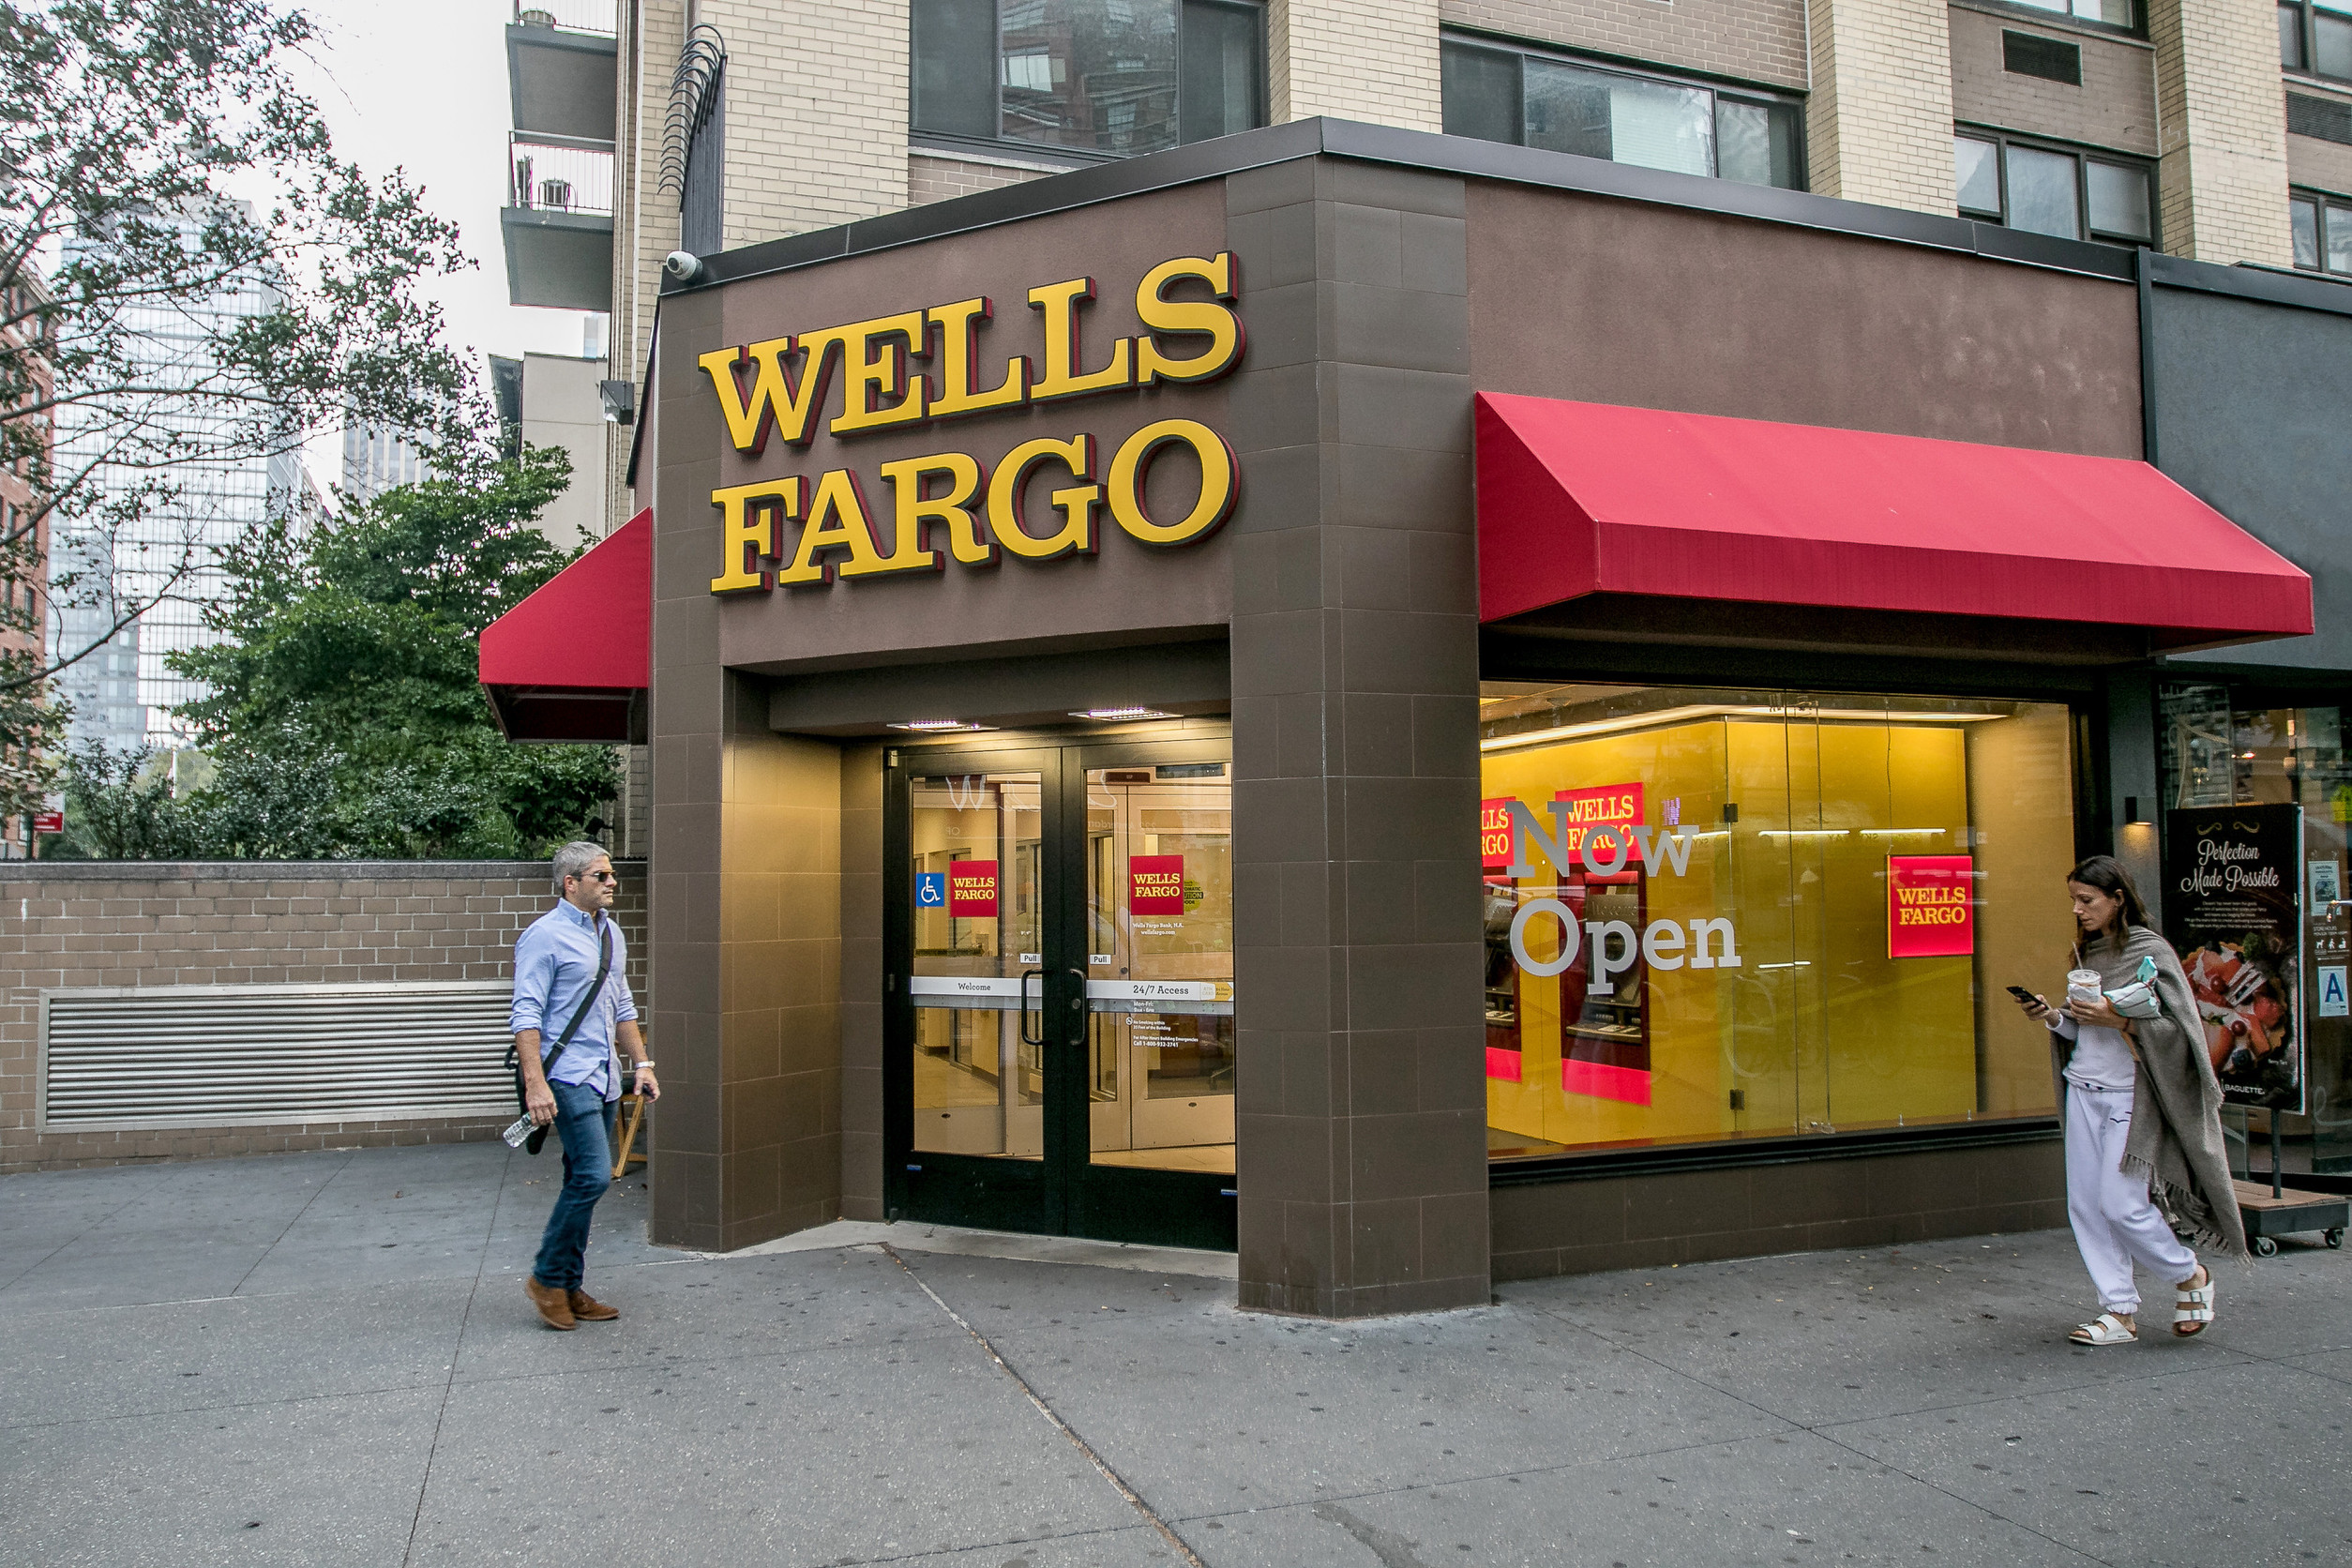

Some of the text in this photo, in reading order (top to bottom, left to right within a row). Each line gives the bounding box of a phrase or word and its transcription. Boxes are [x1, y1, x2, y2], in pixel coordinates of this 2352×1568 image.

[699, 249, 1246, 453] WELLS
[710, 418, 1241, 596] FARGO
[1567, 795, 1635, 823] WELLS
[1505, 800, 1699, 878] Now
[2197, 838, 2259, 866] Perfection
[953, 877, 995, 889] WELLS
[1133, 872, 1181, 885] WELLS
[2180, 867, 2223, 897] Made
[2225, 865, 2280, 893] Possible
[954, 889, 995, 901] FARGO
[1135, 885, 1181, 898] FARGO
[1896, 886, 1966, 905] WELLS
[1899, 906, 1966, 925] FARGO
[1510, 898, 1742, 995] Open
[957, 982, 991, 991] Welcome
[1133, 985, 1189, 995] 24/7 Access
[2325, 972, 2344, 1003] A
[2224, 1084, 2264, 1095] BAGUETTE
